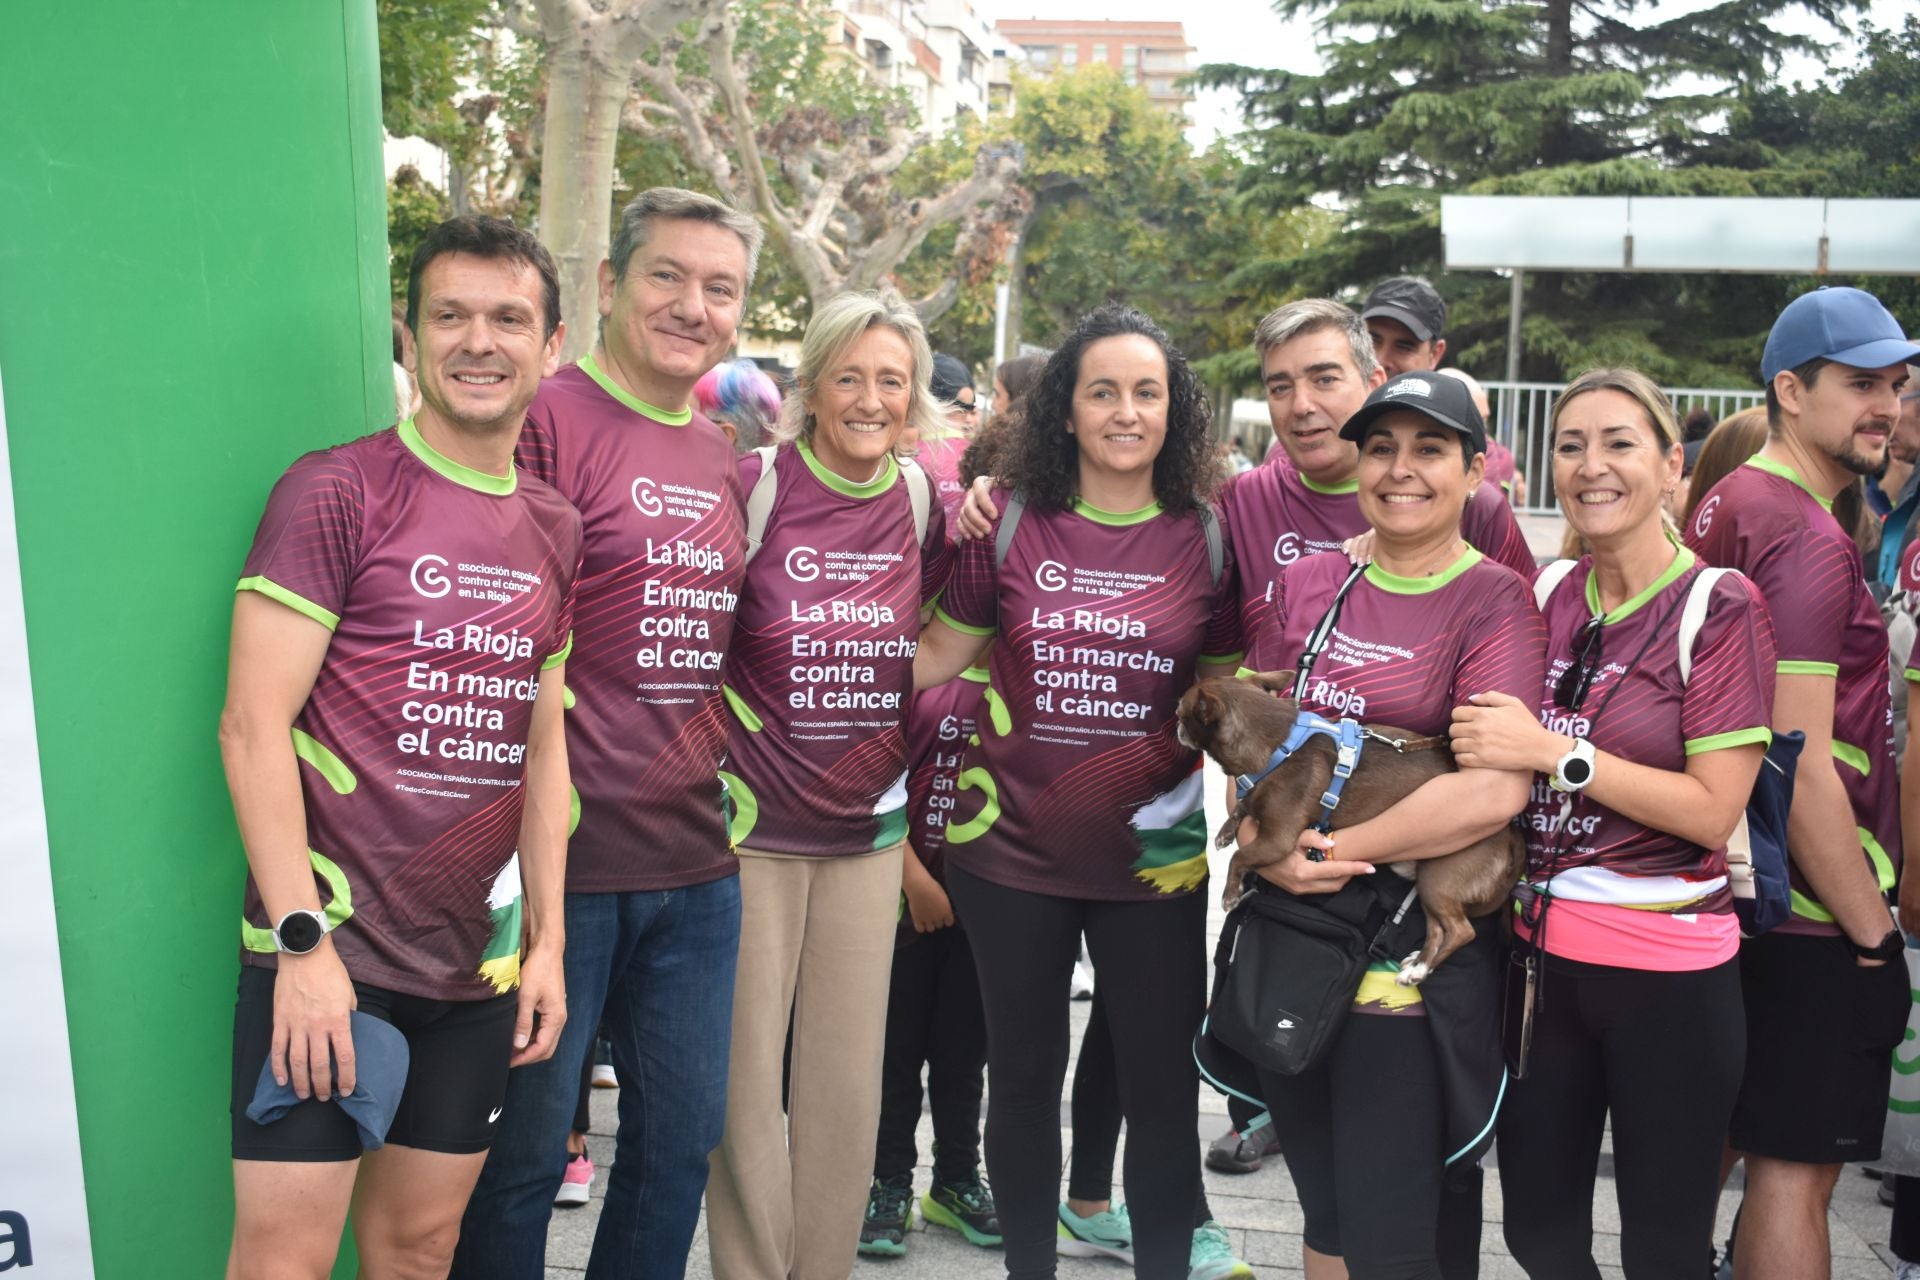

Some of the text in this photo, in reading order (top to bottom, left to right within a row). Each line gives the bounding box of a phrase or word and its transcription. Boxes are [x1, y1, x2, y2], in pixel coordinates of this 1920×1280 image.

[667, 507, 677, 515] en
[676, 507, 685, 517] La
[646, 538, 724, 575] La Rioja
[825, 551, 903, 562] asociación española
[825, 561, 889, 571] contra el cáncer
[458, 562, 542, 585] asociación española
[458, 575, 531, 593] contra el cáncer
[838, 572, 848, 580] La
[849, 573, 869, 582] Rioja
[1073, 567, 1166, 583] asociación española
[1073, 577, 1147, 590] contra el cáncer
[458, 589, 512, 604] en La Rioja
[643, 580, 674, 606] En
[1085, 586, 1097, 595] La
[1099, 587, 1123, 598] Rioja
[791, 600, 895, 628] La Rioja
[1031, 607, 1146, 640] La Rioja
[413, 619, 534, 662] La Rioja
[792, 635, 917, 657] En marcha
[1376, 643, 1414, 659] española
[637, 641, 664, 668] el
[1032, 640, 1174, 674] En marcha
[1354, 649, 1363, 657] el
[1363, 649, 1391, 663] cáncer
[407, 661, 449, 692] En
[790, 661, 875, 683] contra
[1033, 669, 1118, 693] contra
[789, 686, 902, 709] el cáncer
[1035, 690, 1152, 720] el cáncer
[1311, 680, 1366, 717] Rioja
[402, 701, 504, 731] contra
[1065, 726, 1095, 735] ESPAÑOLA
[397, 728, 526, 763] el cáncer
[936, 752, 957, 767] La
[396, 768, 442, 780] ASOCIACIÓN
[443, 775, 477, 785] ESPAÑOLA
[477, 778, 500, 786] CONTRA
[932, 774, 953, 791] En
[926, 810, 943, 827] el
